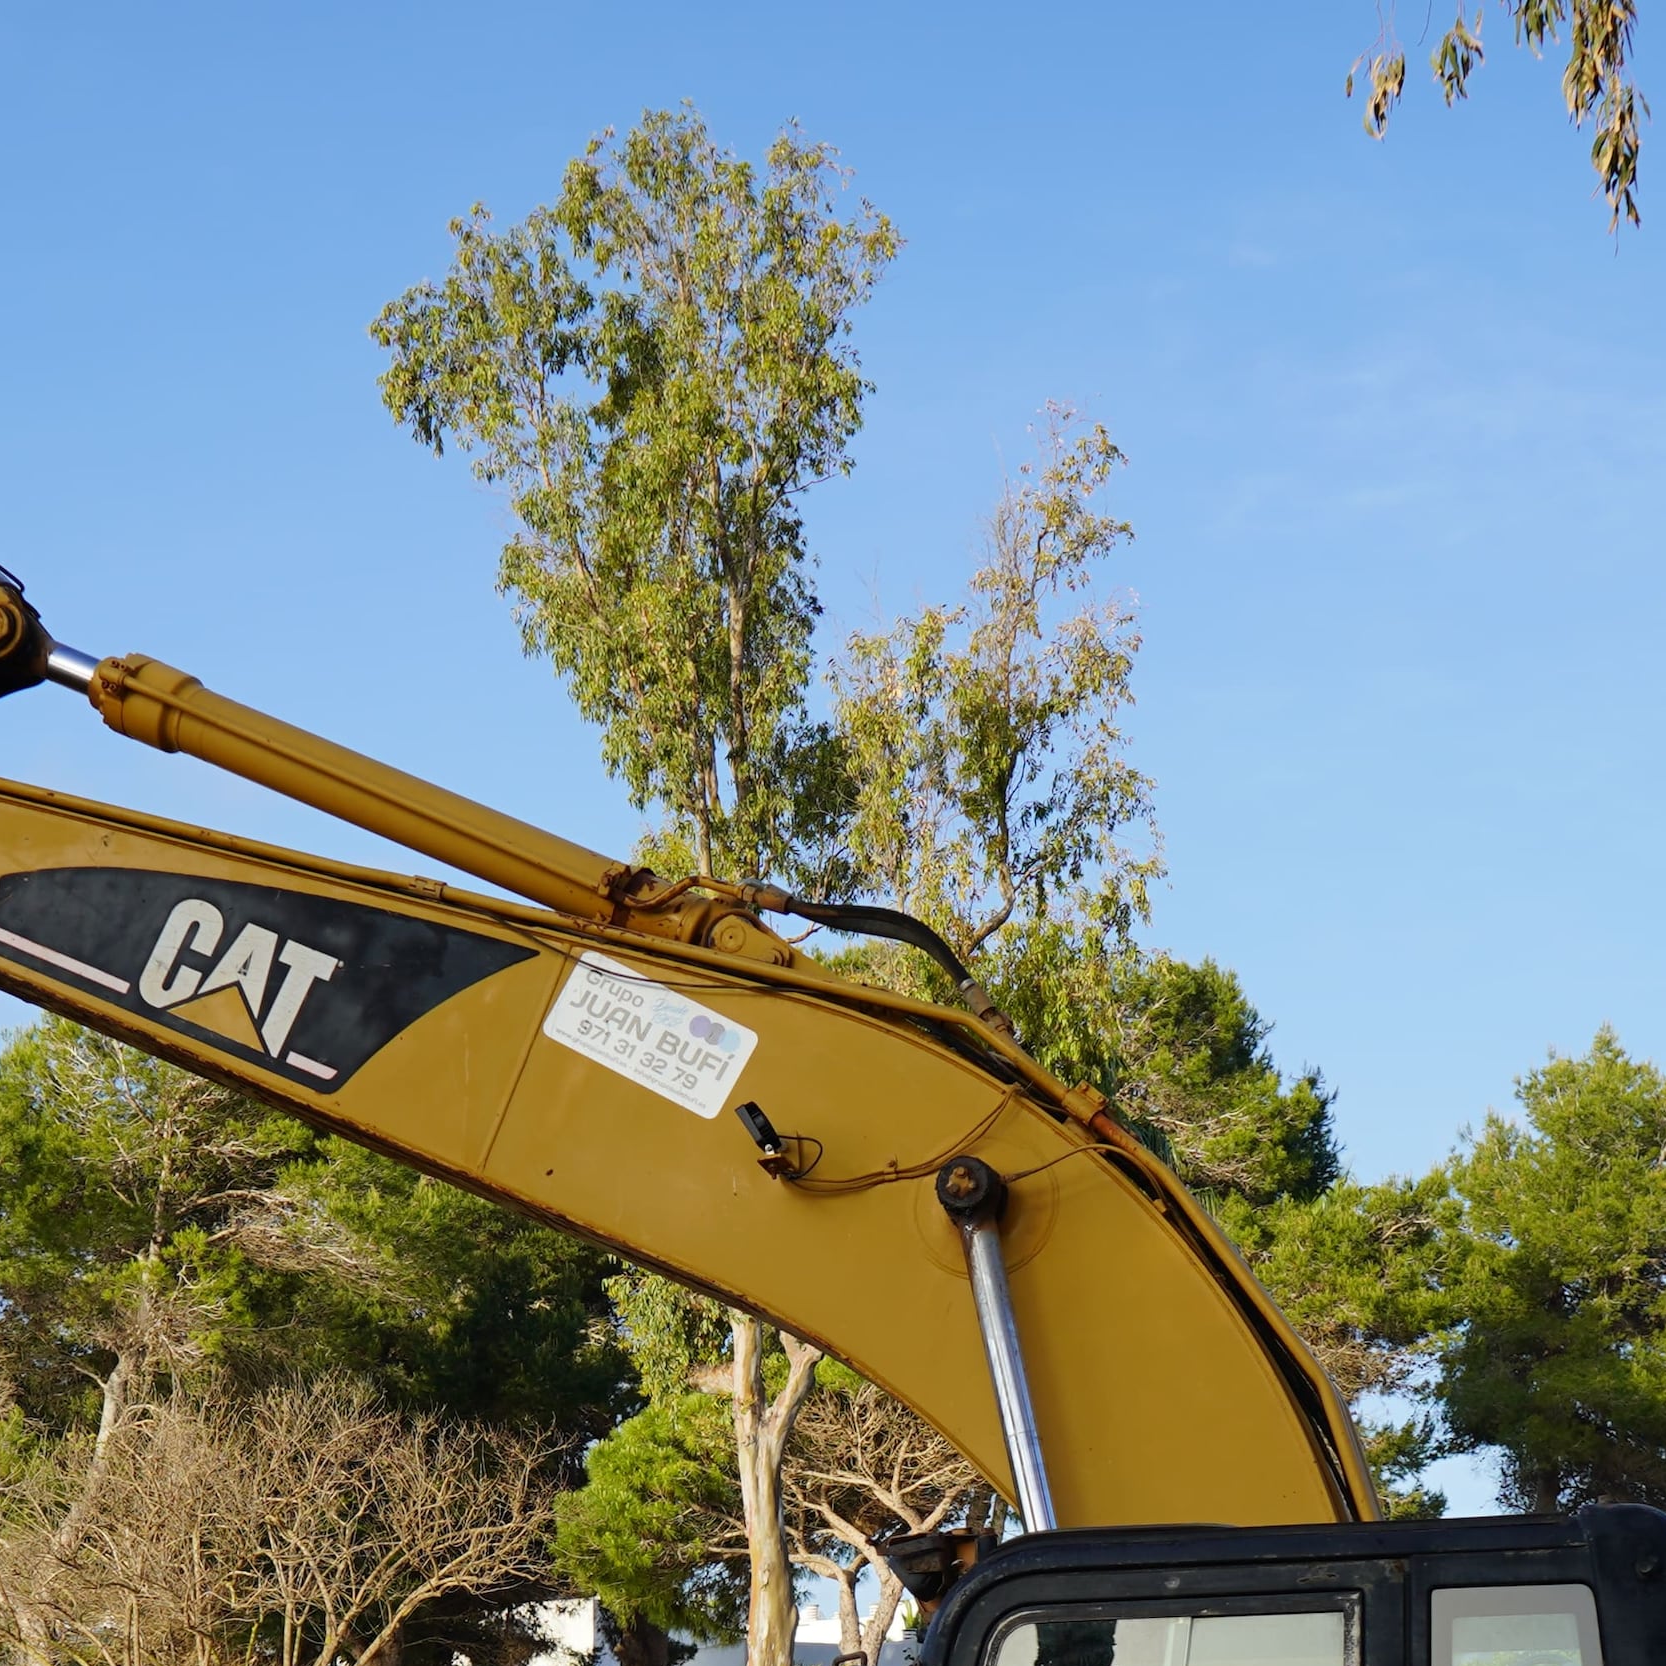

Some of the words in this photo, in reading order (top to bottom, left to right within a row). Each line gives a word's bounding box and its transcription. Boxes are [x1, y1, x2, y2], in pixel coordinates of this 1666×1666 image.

[139, 899, 338, 1058] CAT
[586, 968, 644, 1007] Grupo
[569, 990, 652, 1041] JUAN
[656, 1030, 735, 1081] BUFÍ
[577, 1019, 611, 1045] 971
[614, 1039, 637, 1058] 31
[639, 1052, 668, 1075] 32
[671, 1066, 698, 1090] 79
